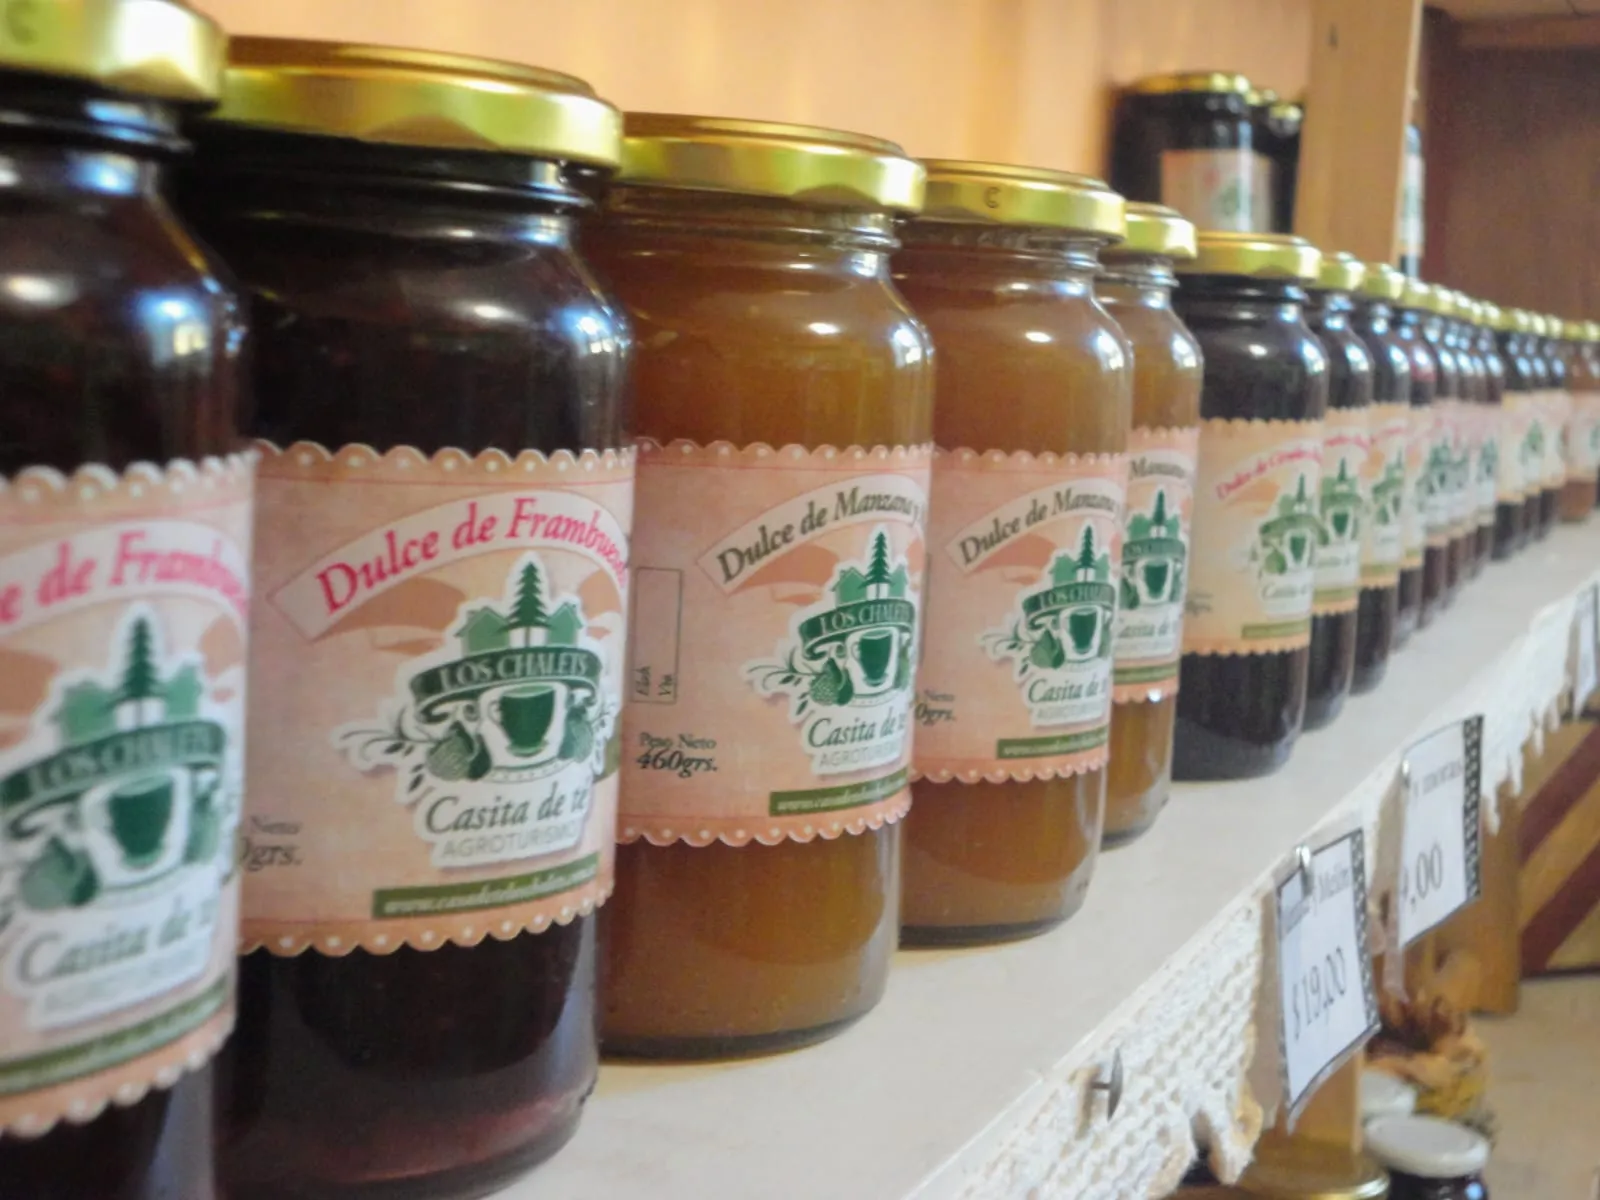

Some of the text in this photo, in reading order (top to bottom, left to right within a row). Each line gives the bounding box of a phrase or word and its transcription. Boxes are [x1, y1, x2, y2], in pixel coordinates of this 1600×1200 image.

[716, 525, 794, 584] Dulce
[800, 501, 828, 535] de
[834, 486, 912, 520] Manzana
[959, 517, 1021, 565] Dulce
[1025, 498, 1048, 523] de
[37, 540, 97, 606] de
[316, 530, 439, 616] Dulce
[451, 501, 498, 551] de
[818, 611, 855, 636] LOS
[440, 651, 589, 691] LOS CHALETS
[1028, 679, 1083, 703] Casita
[808, 717, 876, 748] Casita
[880, 705, 896, 738] de
[636, 750, 718, 778] 460grs.
[426, 795, 529, 834] Casita
[538, 781, 566, 819] de
[443, 820, 579, 857] AGROTURISMO
